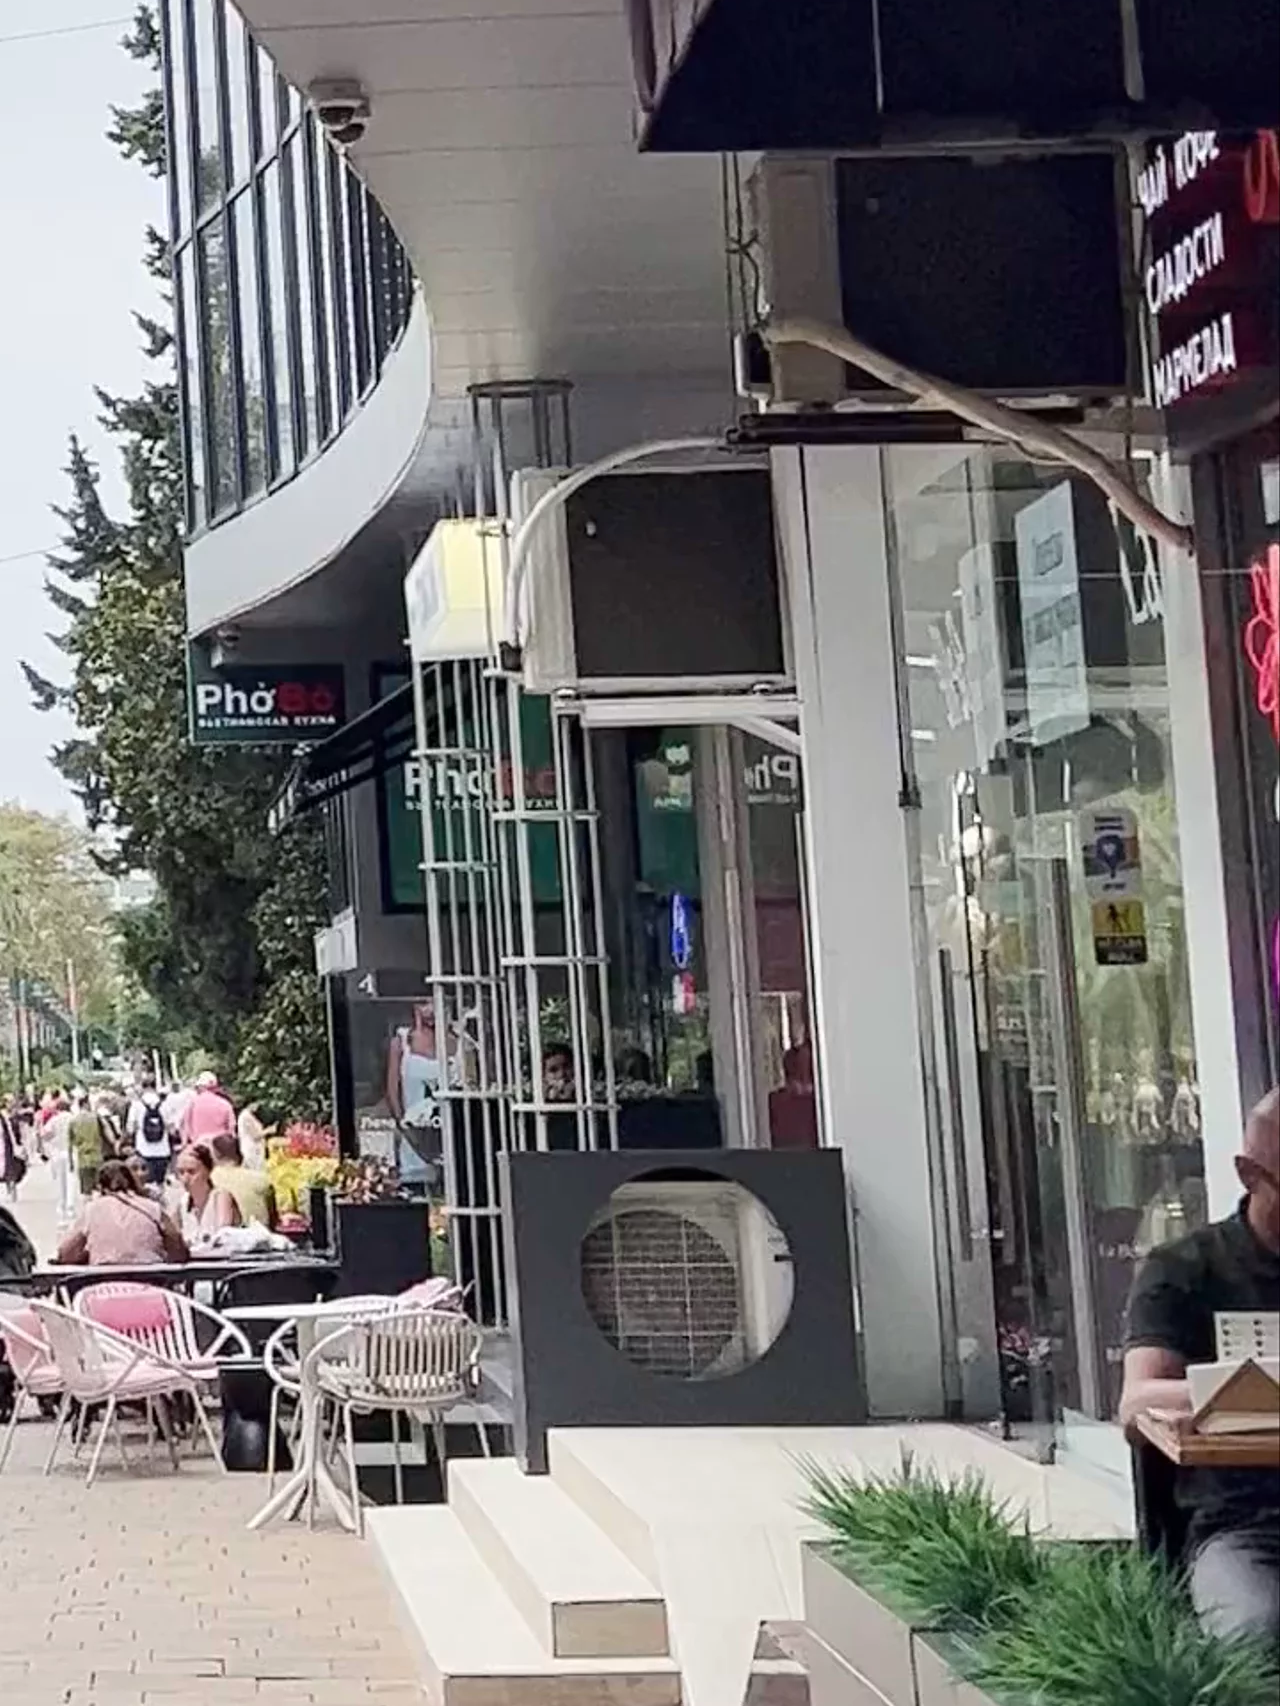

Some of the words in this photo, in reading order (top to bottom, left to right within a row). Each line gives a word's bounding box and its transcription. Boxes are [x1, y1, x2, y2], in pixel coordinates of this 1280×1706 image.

[1137, 144, 1169, 218] ЧАЙ
[1145, 212, 1225, 315] СЛАДОСТИ
[1153, 312, 1237, 410] МАРМЕЛАД
